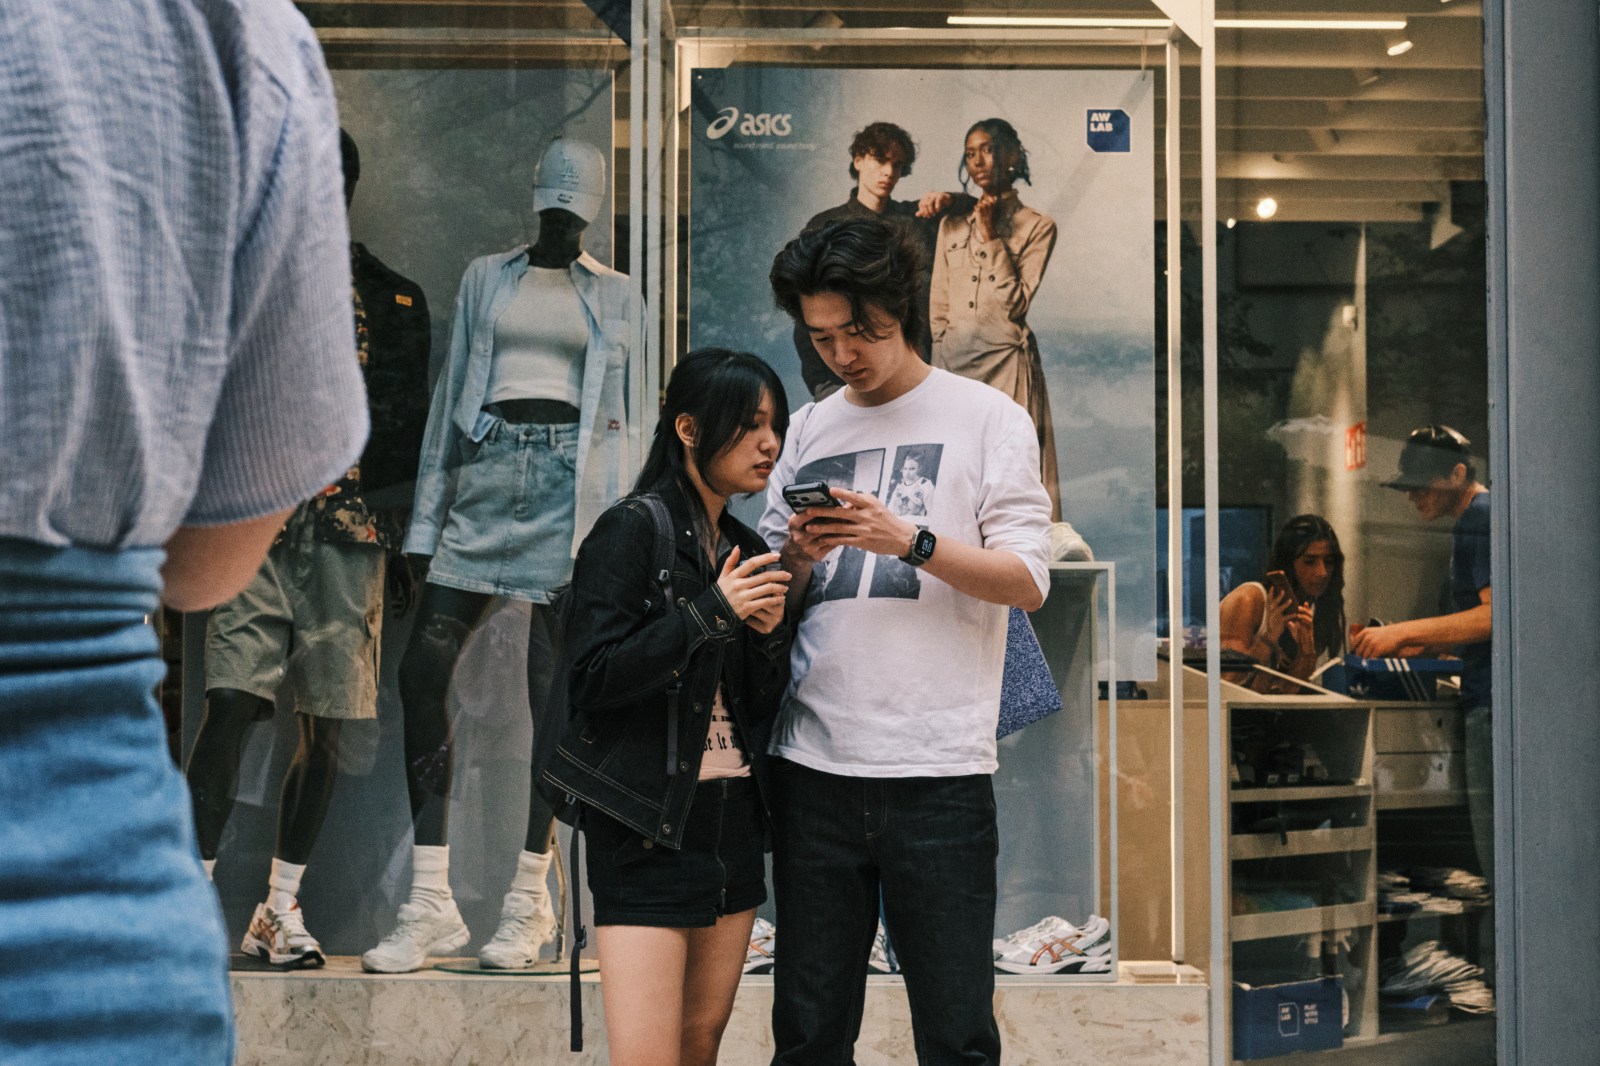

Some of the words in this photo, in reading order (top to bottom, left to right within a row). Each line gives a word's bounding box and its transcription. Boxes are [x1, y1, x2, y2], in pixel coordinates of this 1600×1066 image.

[1090, 112, 1111, 122] AW
[740, 113, 792, 136] asics
[1090, 122, 1113, 132] LAB
